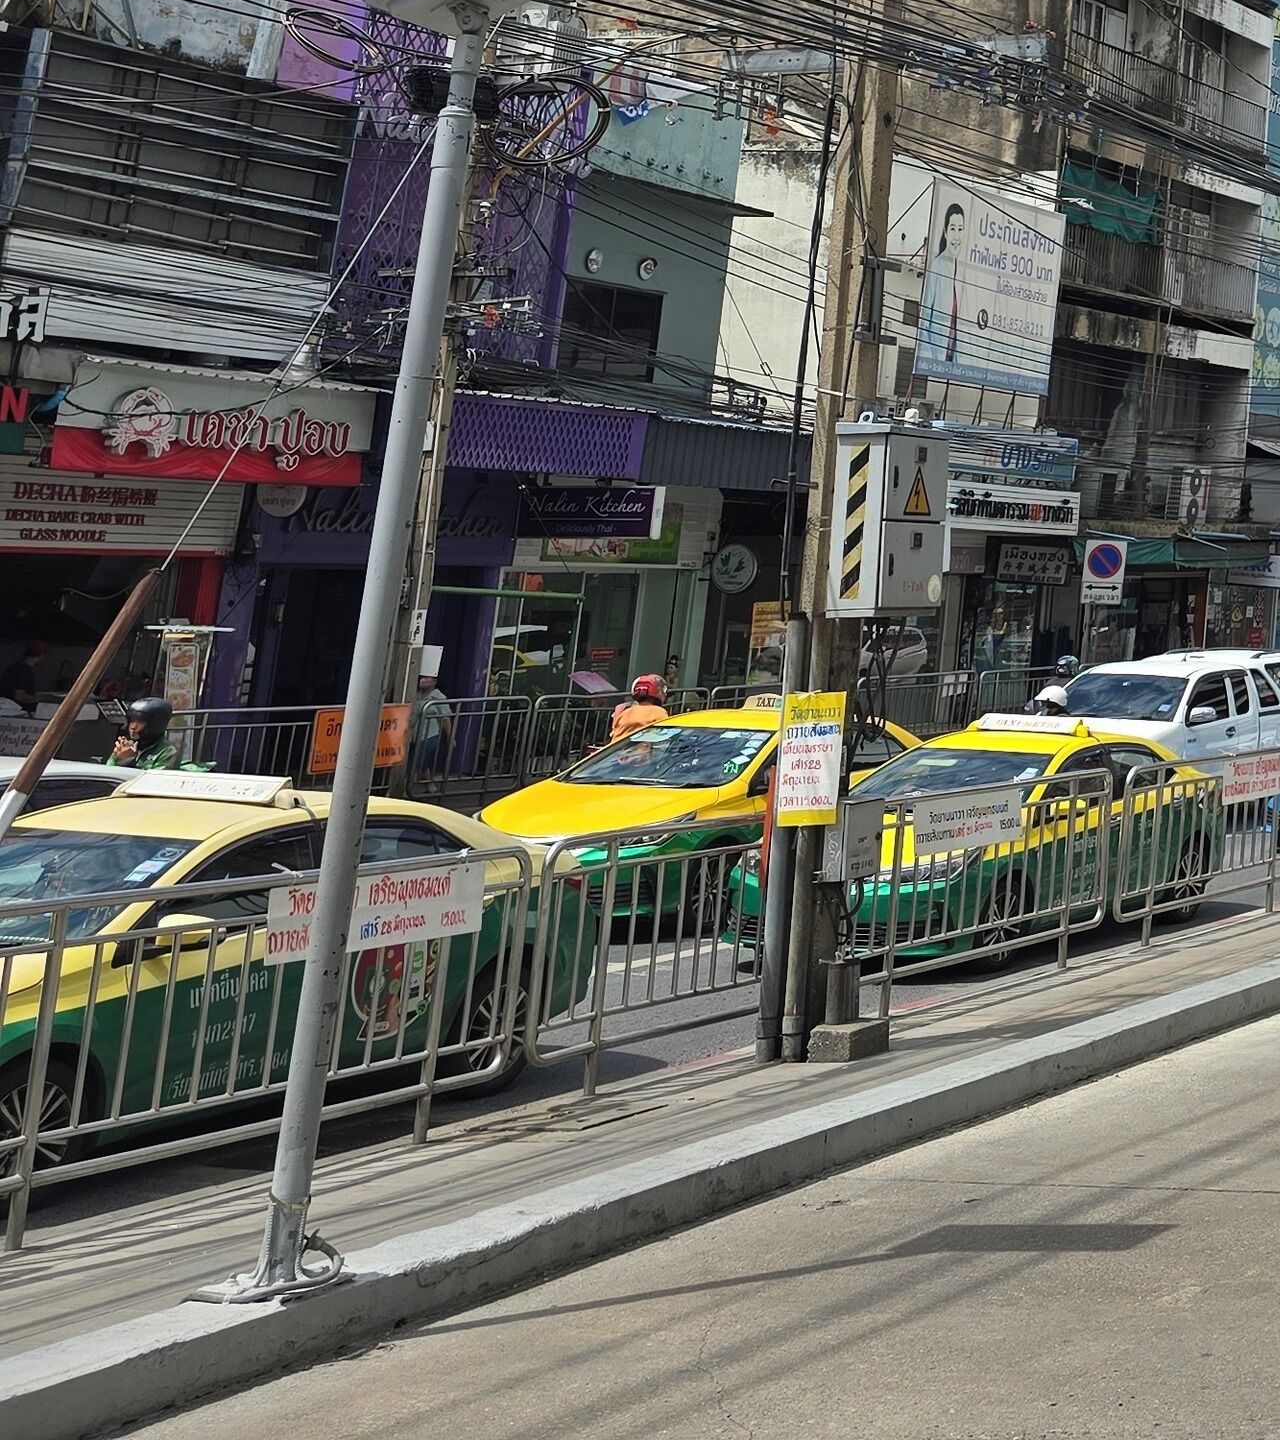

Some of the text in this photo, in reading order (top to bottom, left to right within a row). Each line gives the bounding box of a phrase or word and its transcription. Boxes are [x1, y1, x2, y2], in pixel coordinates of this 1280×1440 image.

[1010, 256, 1035, 277] 900
[279, 407, 353, 472] ปูอบ
[13, 481, 78, 503] DECHA
[530, 489, 646, 517] Nalin Kitchen
[5, 508, 146, 527] DECHA BAKE CRAB WITH
[19, 527, 107, 542] GLASS NOODLE
[756, 696, 777, 708] TAXI
